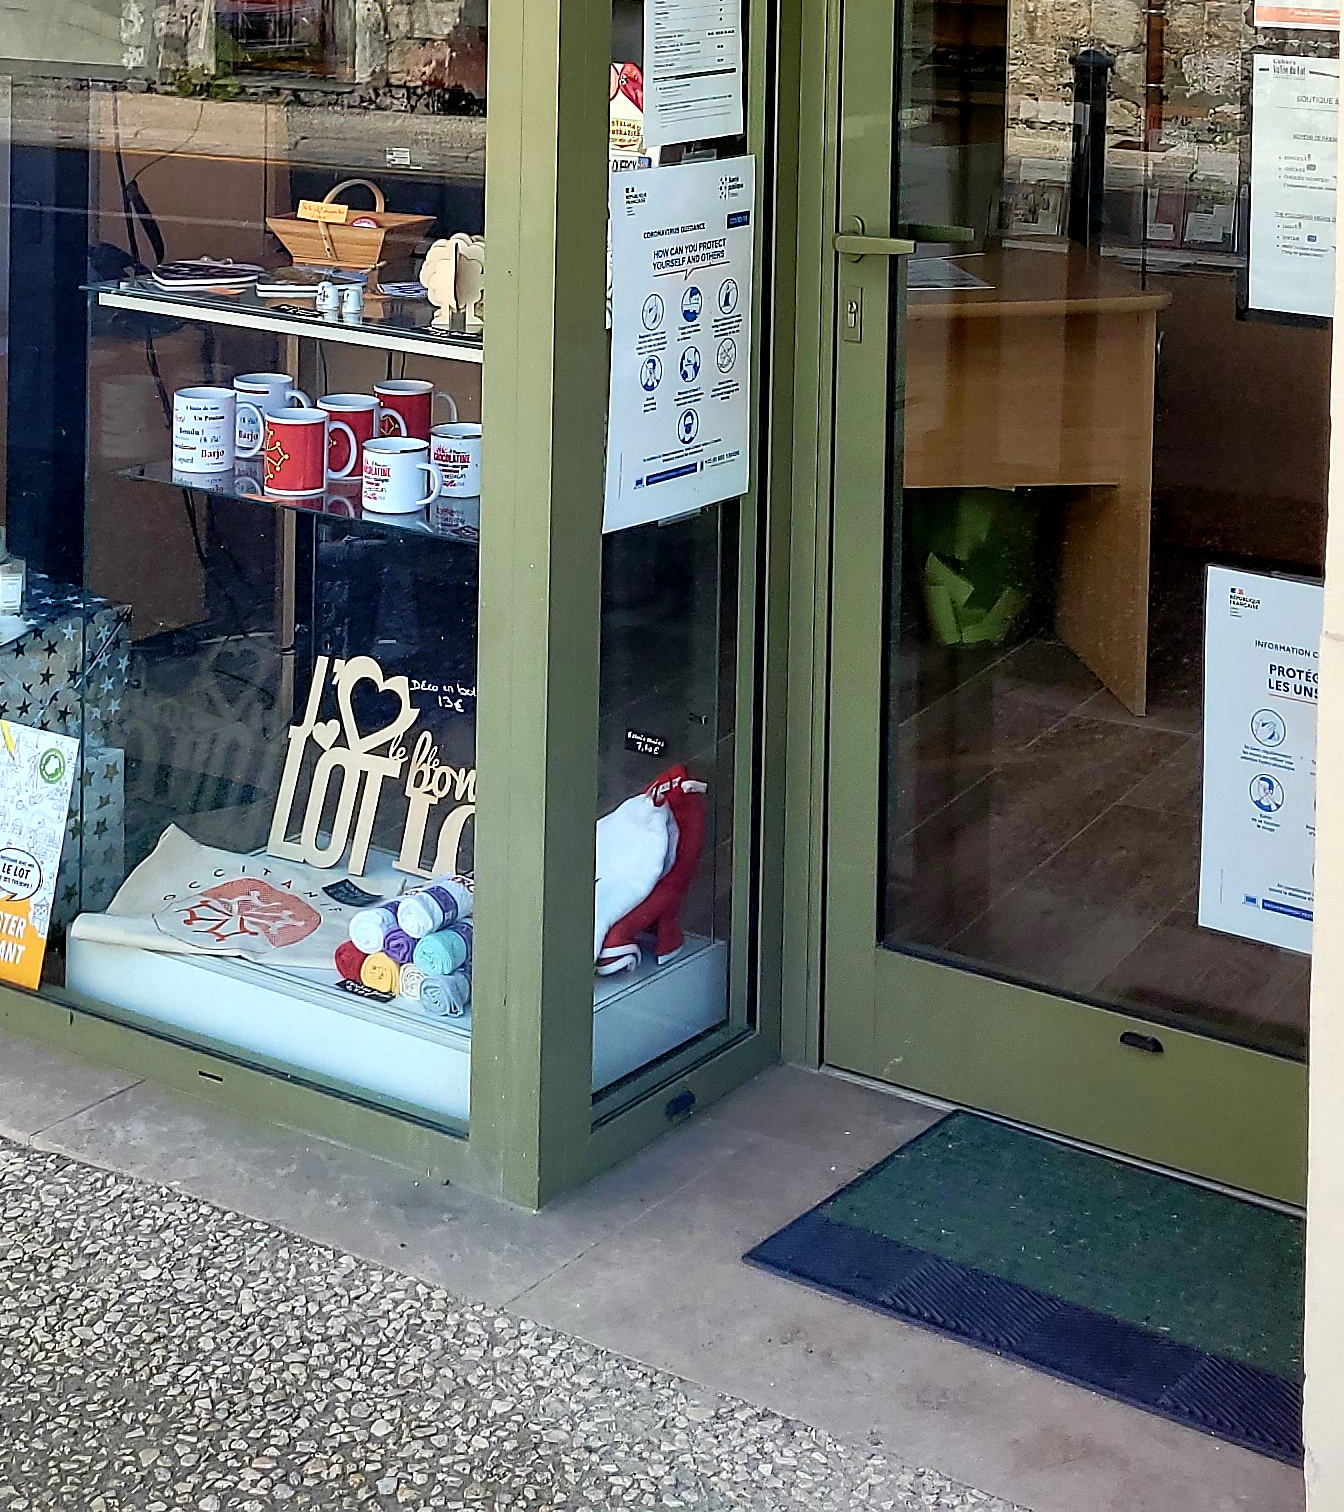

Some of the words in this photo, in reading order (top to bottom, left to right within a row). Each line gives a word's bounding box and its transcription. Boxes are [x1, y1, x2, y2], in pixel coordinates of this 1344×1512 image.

[654, 248, 668, 259] HOW
[670, 245, 683, 256] CAN
[684, 243, 697, 254] YOU
[698, 238, 727, 251] PROTECT
[652, 256, 686, 270] YOURSELF
[687, 253, 700, 264] AND
[701, 250, 725, 262] OTHERS
[1255, 639, 1311, 657] INFORMATION
[1269, 663, 1318, 684] PROTÉG
[1268, 678, 1290, 693] LES
[438, 695, 465, 713] 13€
[266, 738, 402, 877] LOT
[1, 862, 12, 875] LE
[13, 865, 31, 880] LOT
